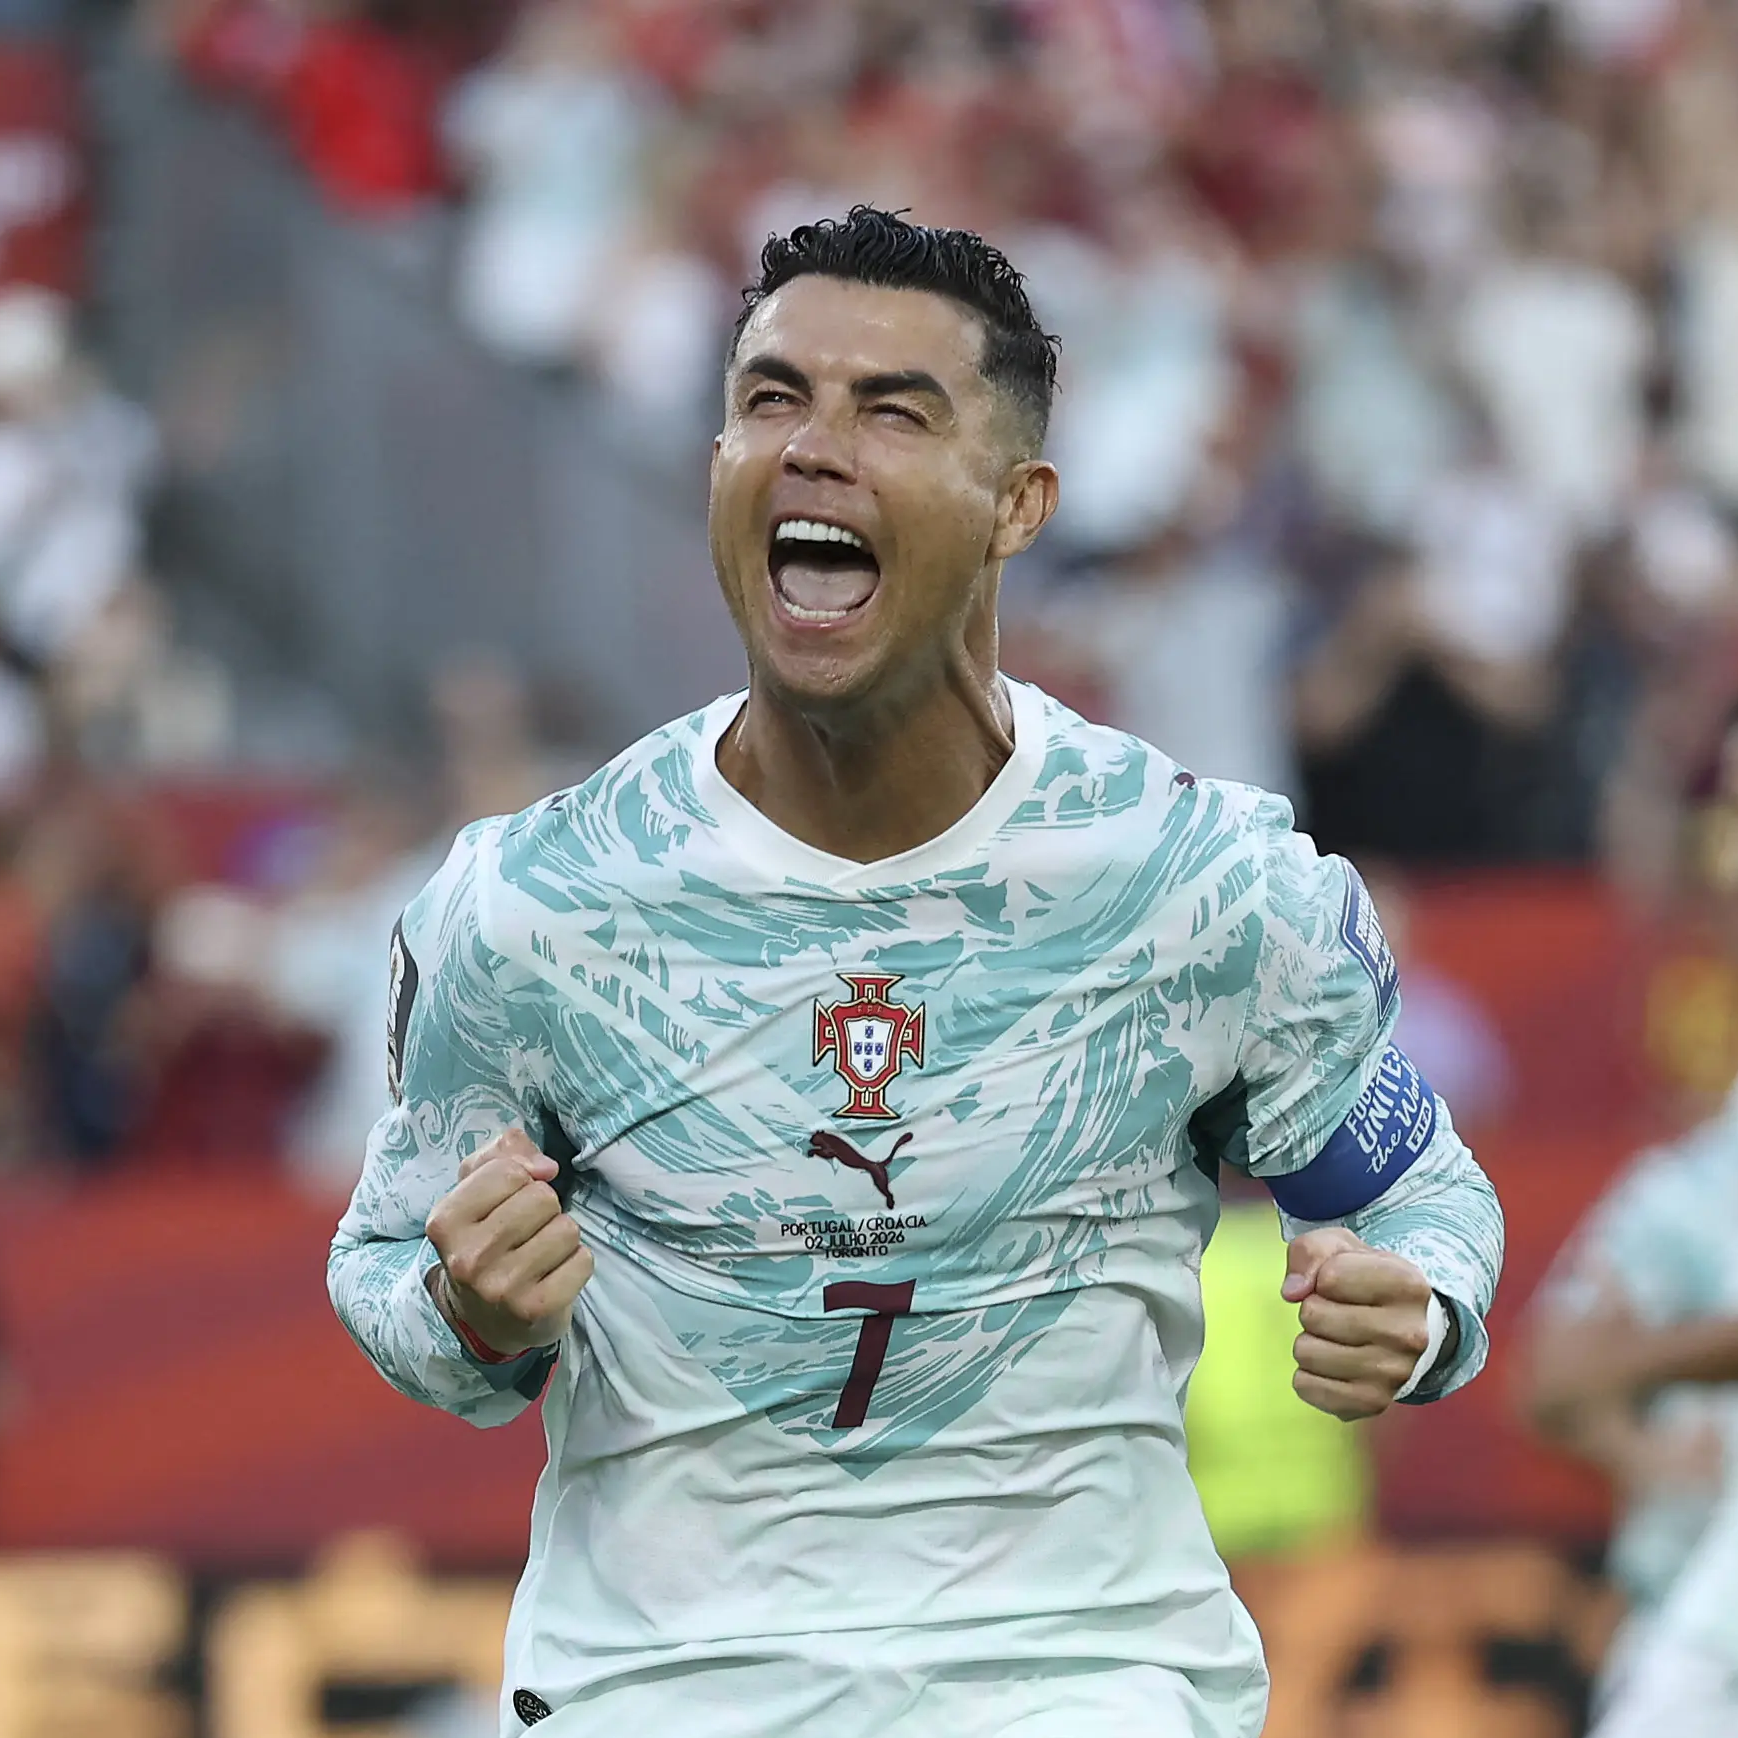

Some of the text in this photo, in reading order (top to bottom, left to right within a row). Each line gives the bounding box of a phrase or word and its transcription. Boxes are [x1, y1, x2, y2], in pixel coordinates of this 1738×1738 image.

[781, 1219, 855, 1237] PORTUGAL
[804, 1230, 906, 1250] 02 JULHO 2026
[823, 1245, 889, 1259] TORONTO
[824, 1277, 917, 1430] 7
